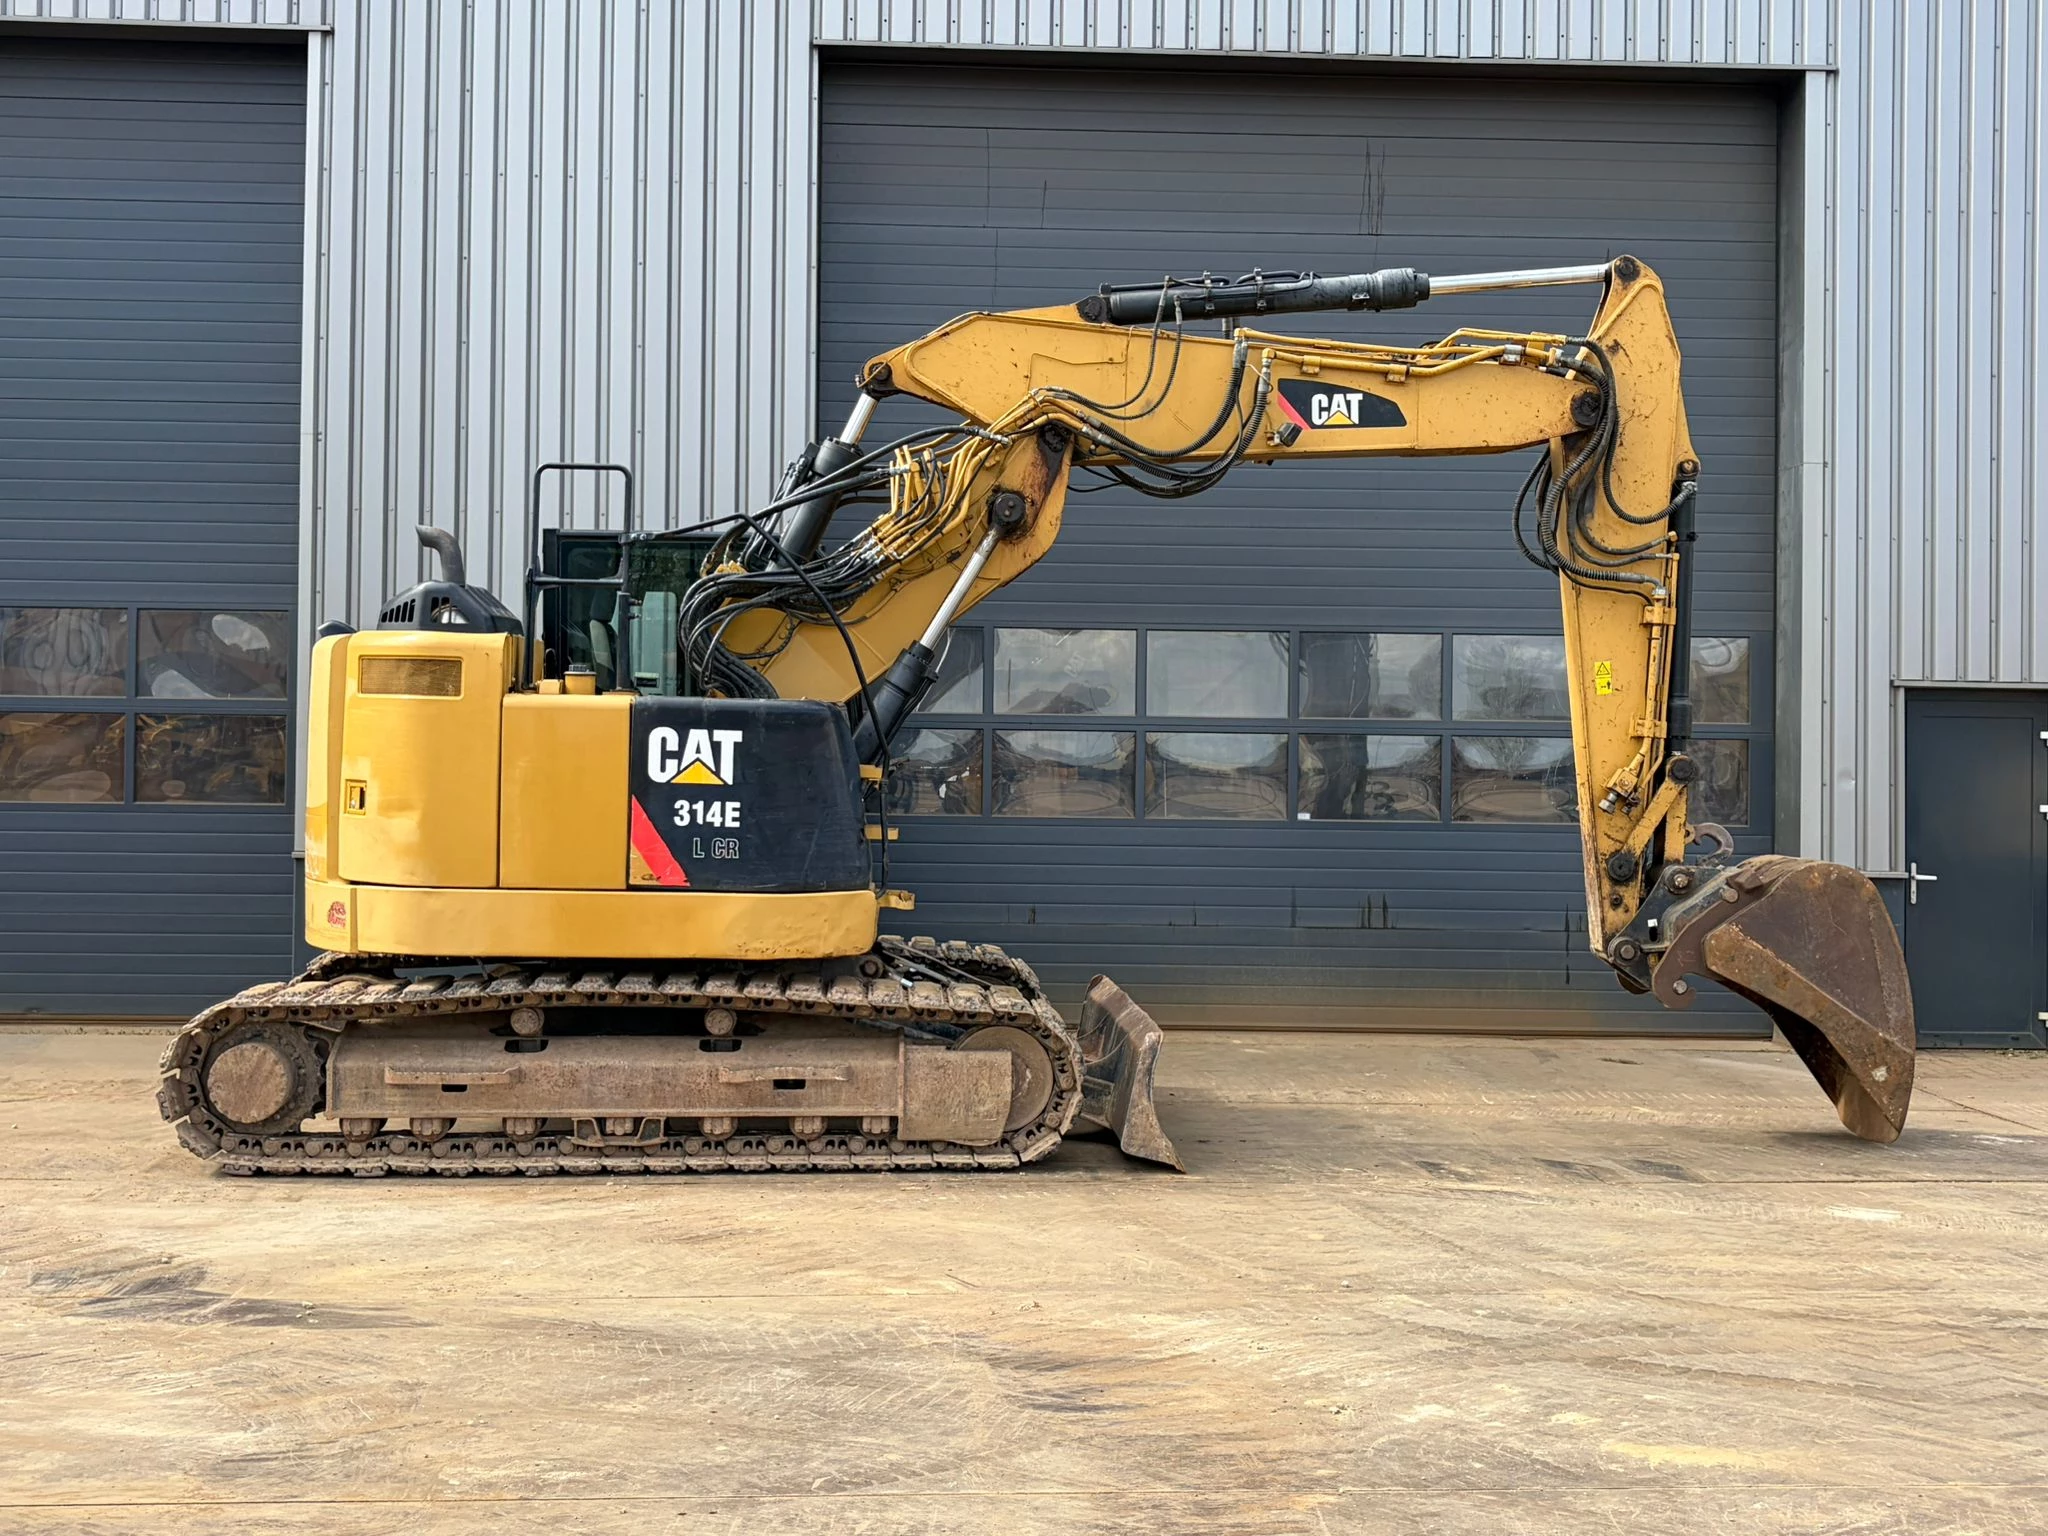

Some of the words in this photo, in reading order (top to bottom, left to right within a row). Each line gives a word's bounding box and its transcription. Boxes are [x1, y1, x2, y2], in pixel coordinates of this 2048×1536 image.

[1311, 393, 1363, 426] CAT
[647, 726, 743, 786] CAT
[673, 799, 741, 828] 314E
[693, 838, 705, 858] L
[711, 838, 740, 859] CR
